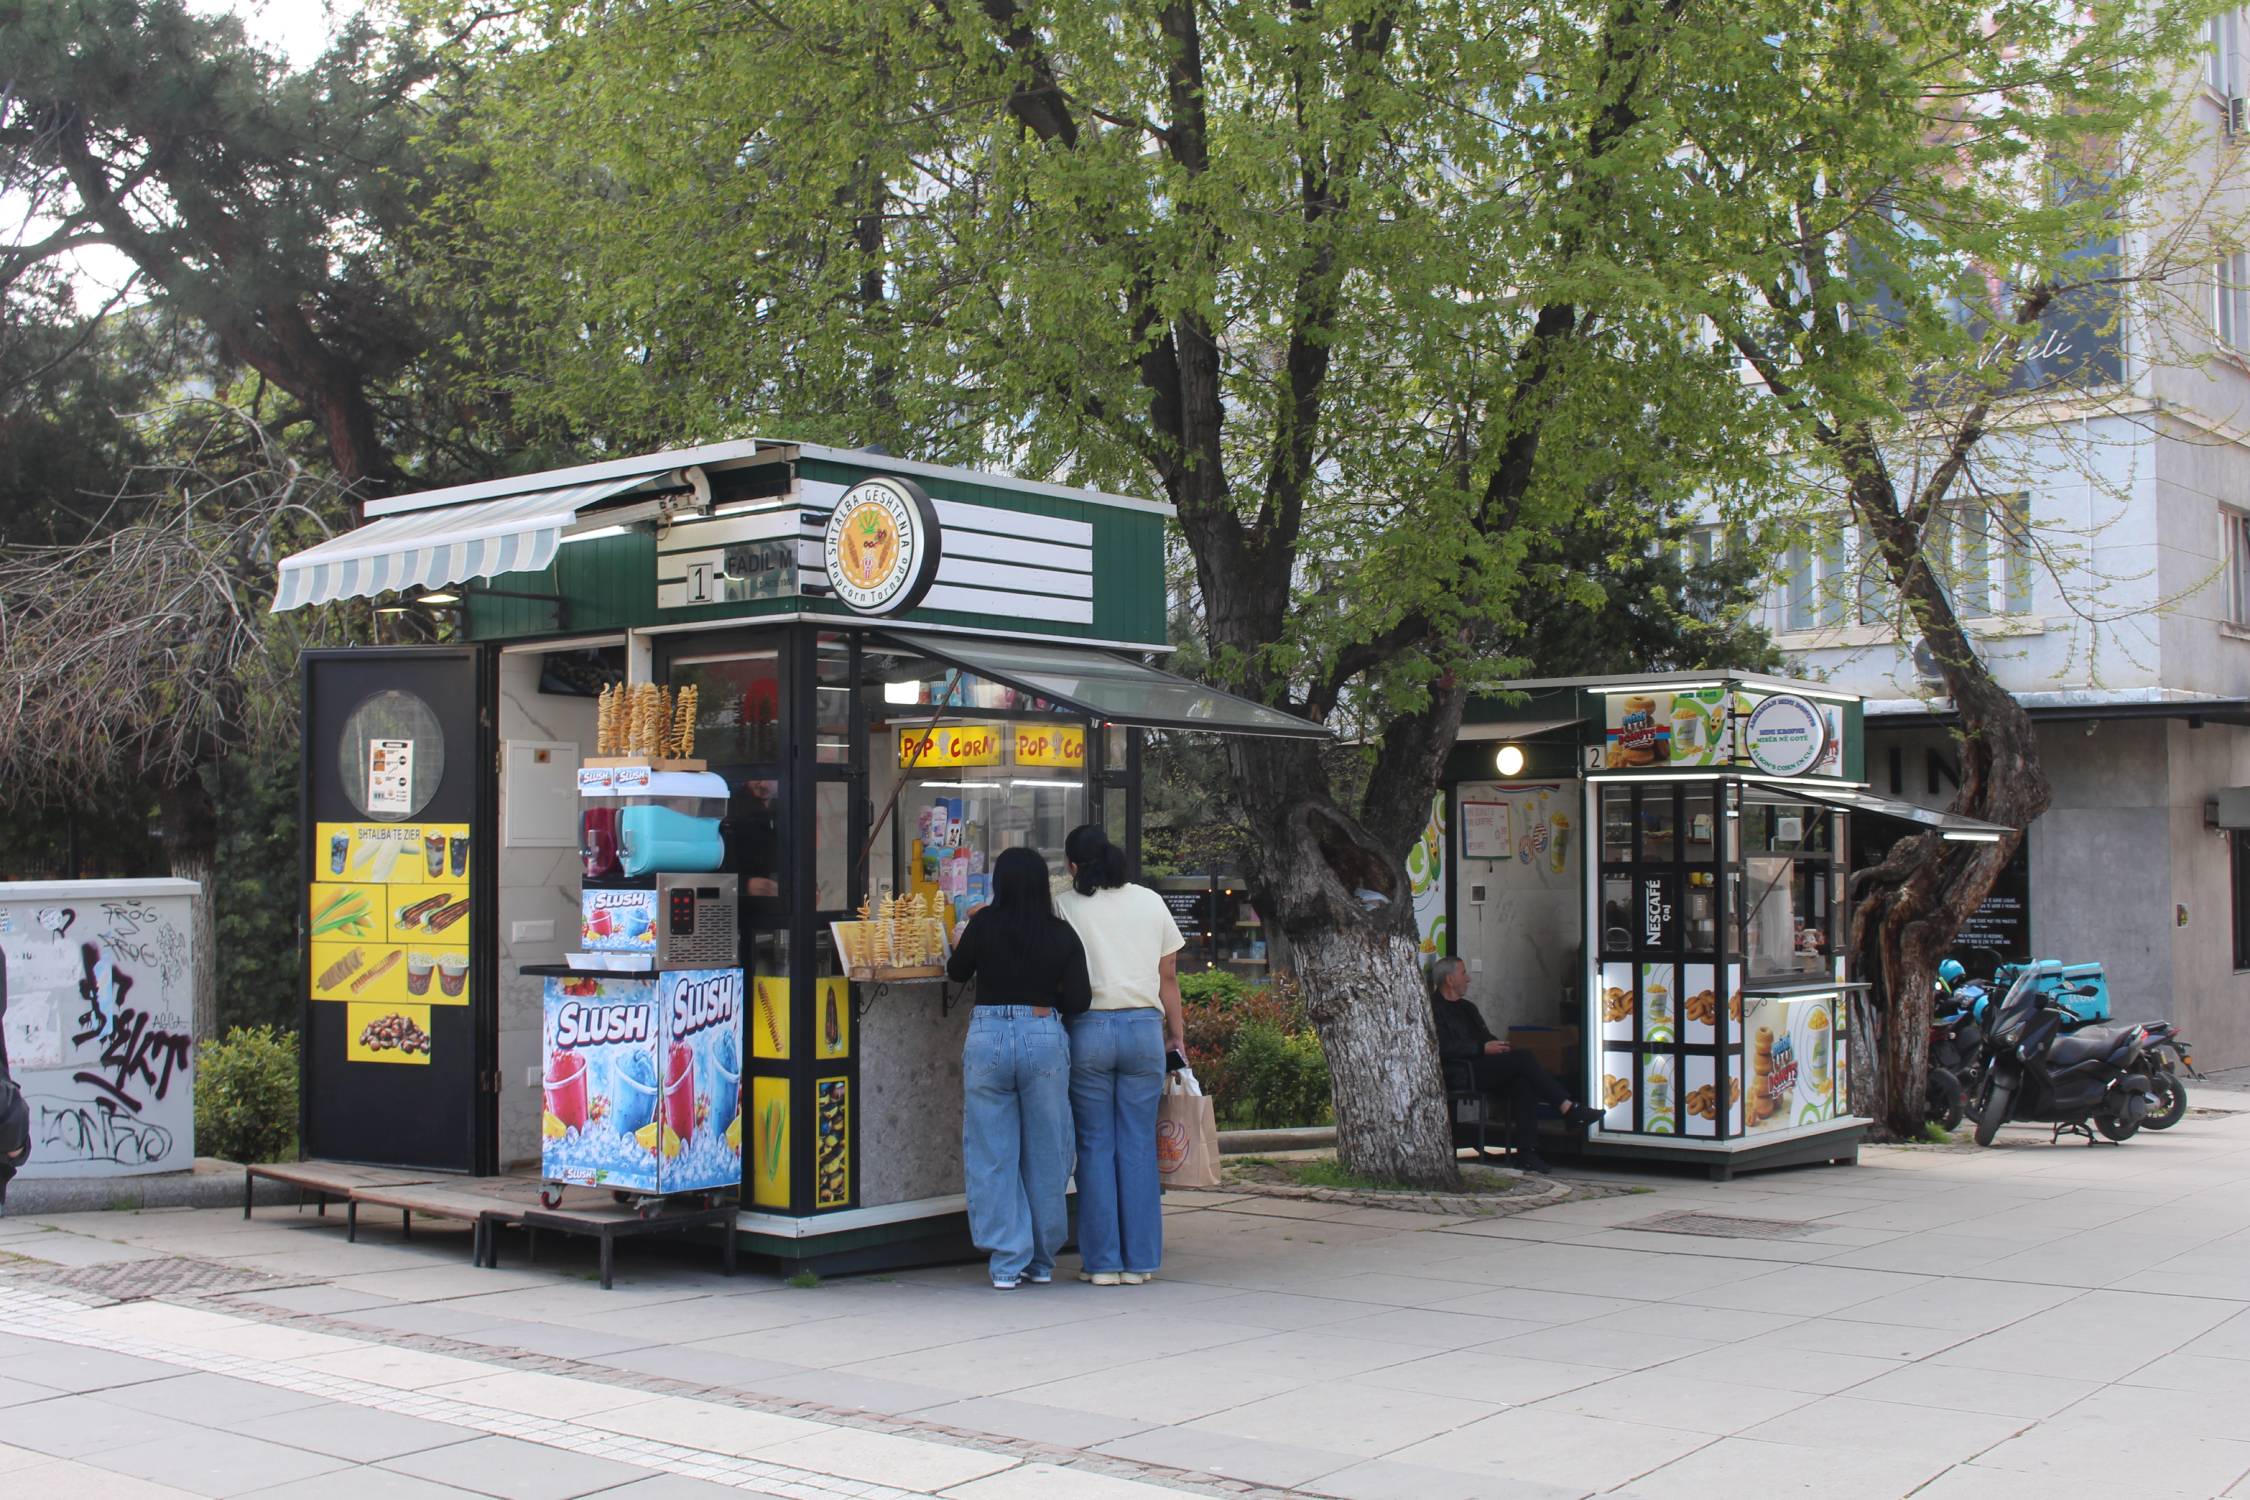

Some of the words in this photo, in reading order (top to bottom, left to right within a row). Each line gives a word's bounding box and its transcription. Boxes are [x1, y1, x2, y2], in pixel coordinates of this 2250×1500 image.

[828, 494, 860, 556] SHTALBA
[865, 489, 910, 549] GESHTENJA
[728, 552, 775, 575] FADIL
[694, 567, 705, 600] 1
[904, 737, 934, 758] POP
[951, 736, 995, 758] CORN
[1019, 735, 1048, 757] POP
[1590, 748, 1601, 768] 2
[583, 772, 609, 783] SLUSH
[619, 770, 646, 782] SLUSH
[358, 828, 391, 840] SHTALBA
[393, 828, 402, 840] TE
[404, 828, 420, 840] ZIER
[594, 892, 646, 909] SLUSH
[1645, 879, 1661, 946] NESCAFÉ
[672, 975, 734, 1041] SLUSH
[557, 1001, 649, 1049] SLUSH
[566, 1166, 593, 1180] SLUSH
